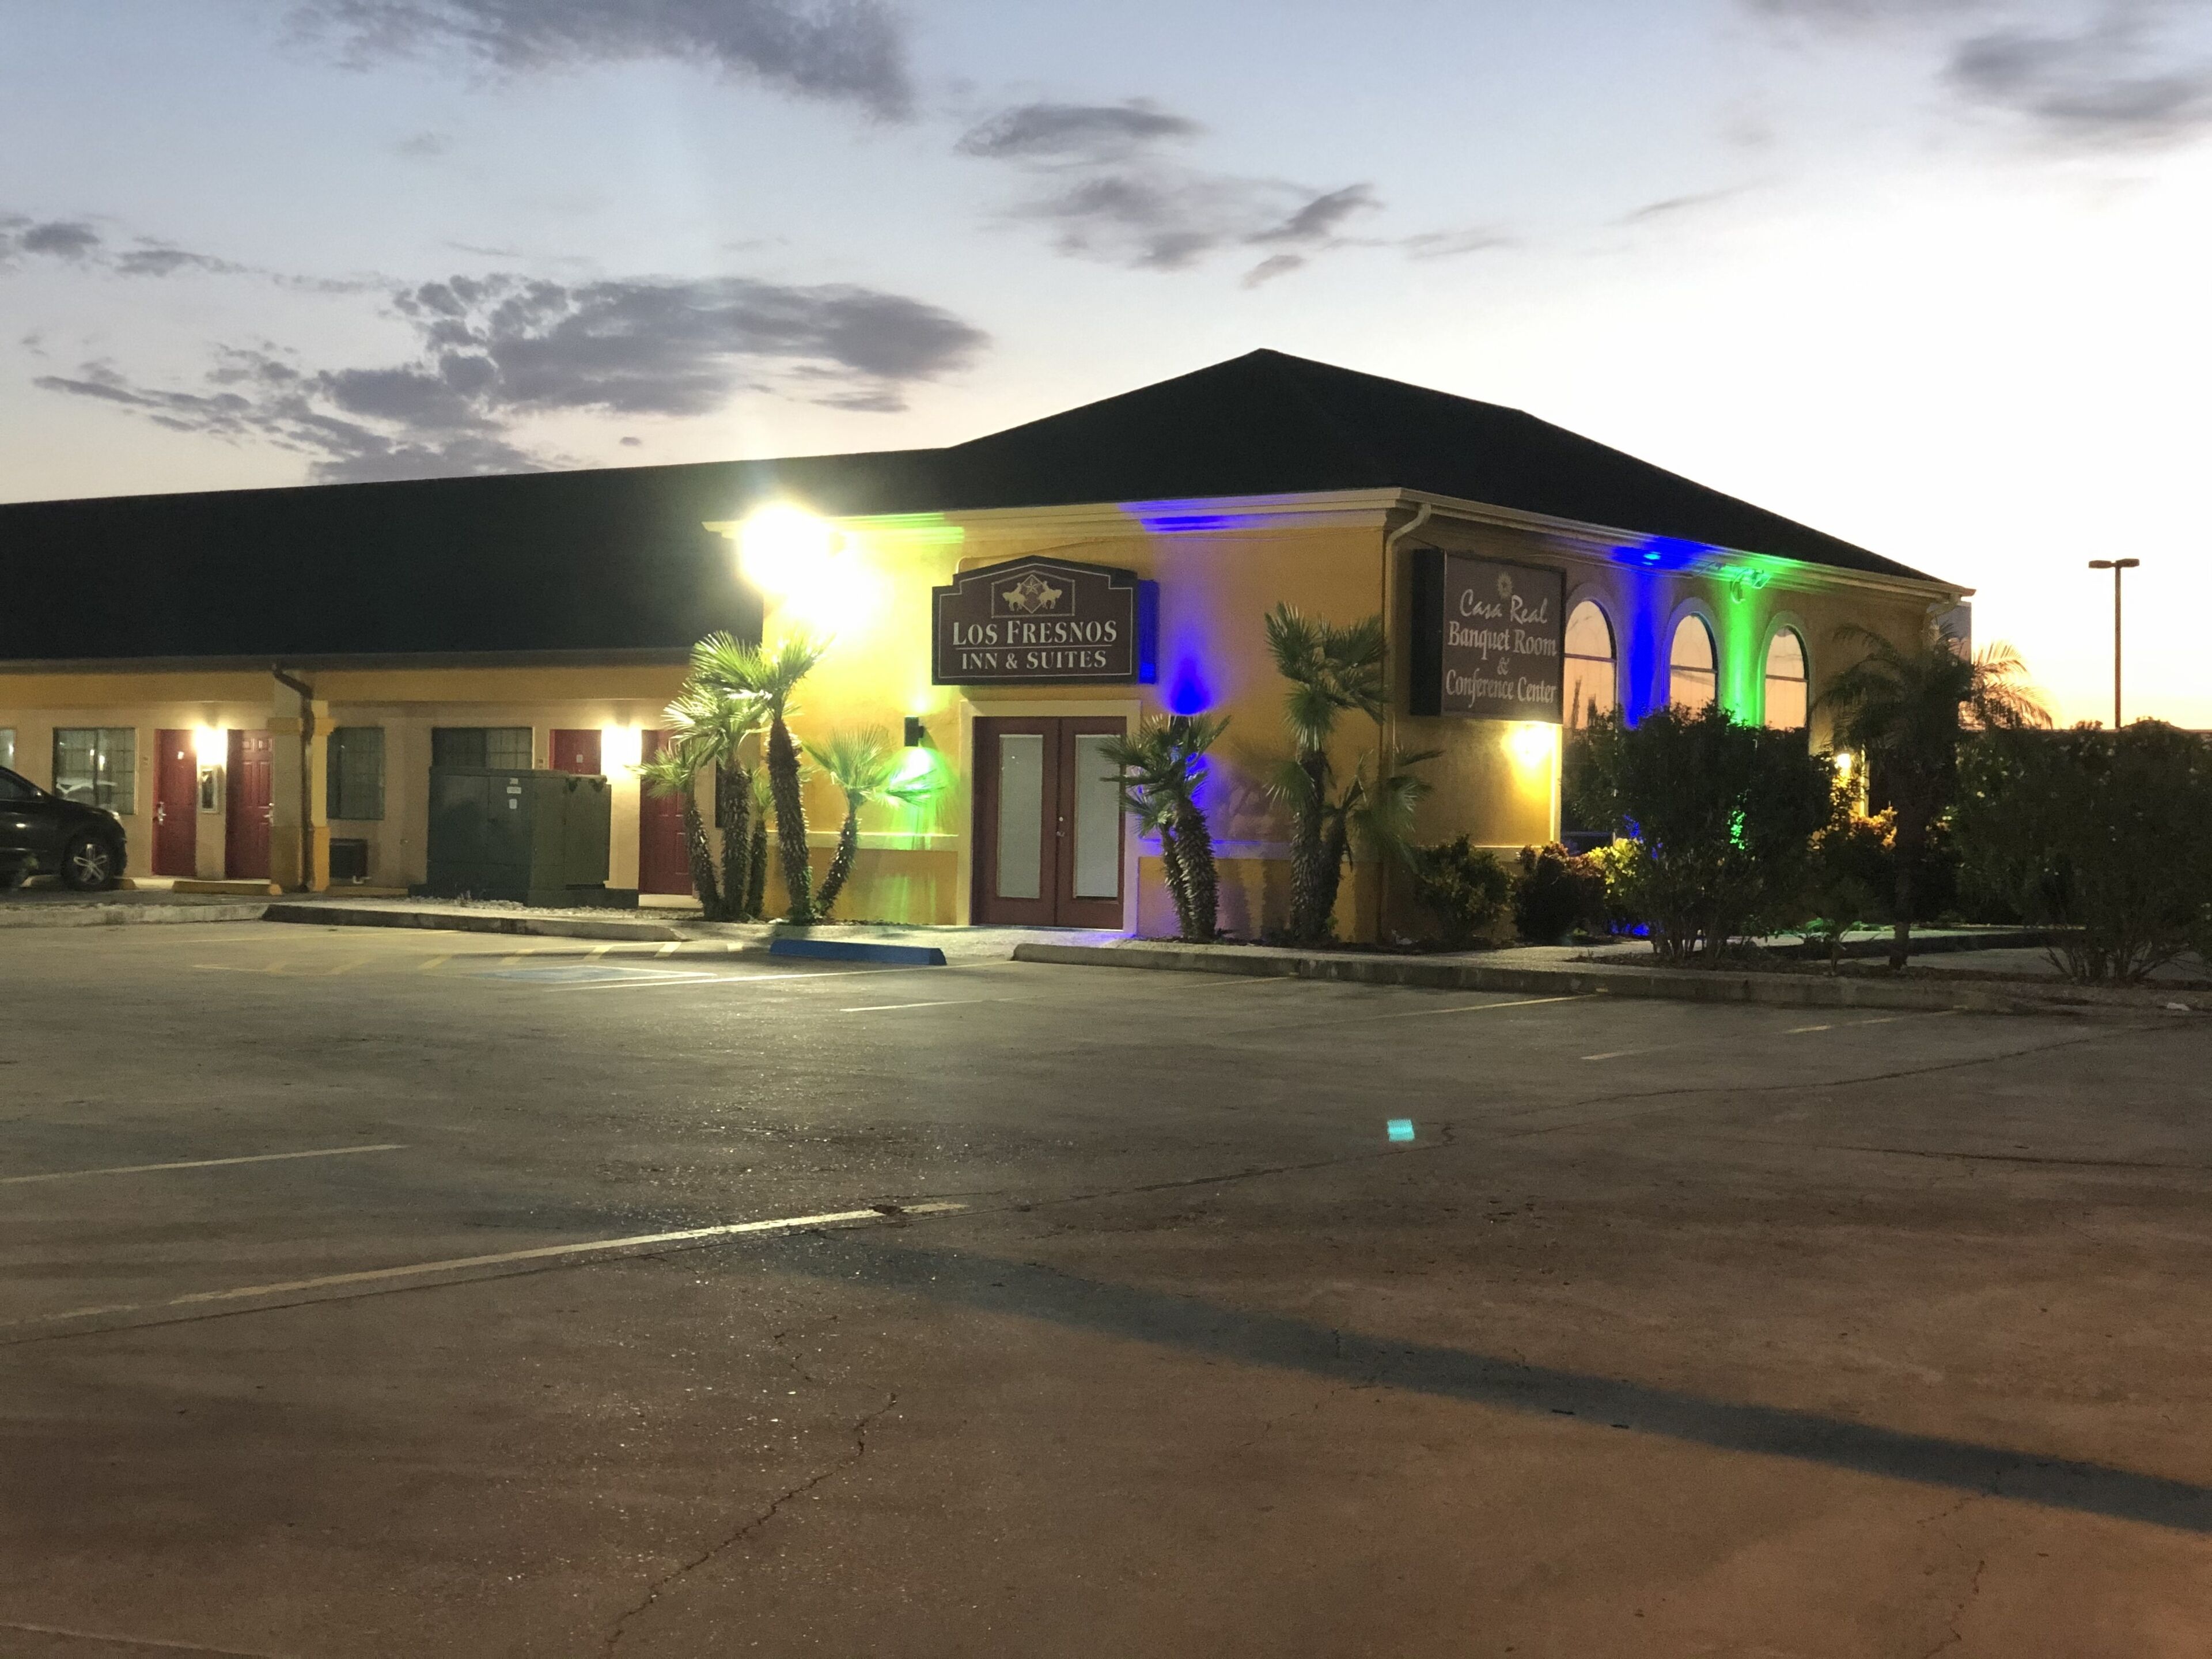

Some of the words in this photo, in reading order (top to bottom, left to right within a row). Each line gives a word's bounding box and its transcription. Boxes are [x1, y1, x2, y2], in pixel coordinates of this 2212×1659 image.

[1460, 589, 1502, 619] Casa
[1510, 594, 1548, 624] Real
[952, 622, 998, 645] LOS
[1006, 620, 1117, 644] FRESNOS
[1448, 621, 1510, 660] Banquet
[1513, 629, 1558, 657] Room
[962, 652, 998, 669] INN
[1006, 653, 1018, 669] &
[1026, 650, 1107, 669] SUITES
[1498, 657, 1510, 675] &
[1446, 668, 1514, 708] Conference
[1517, 677, 1556, 703] Center
